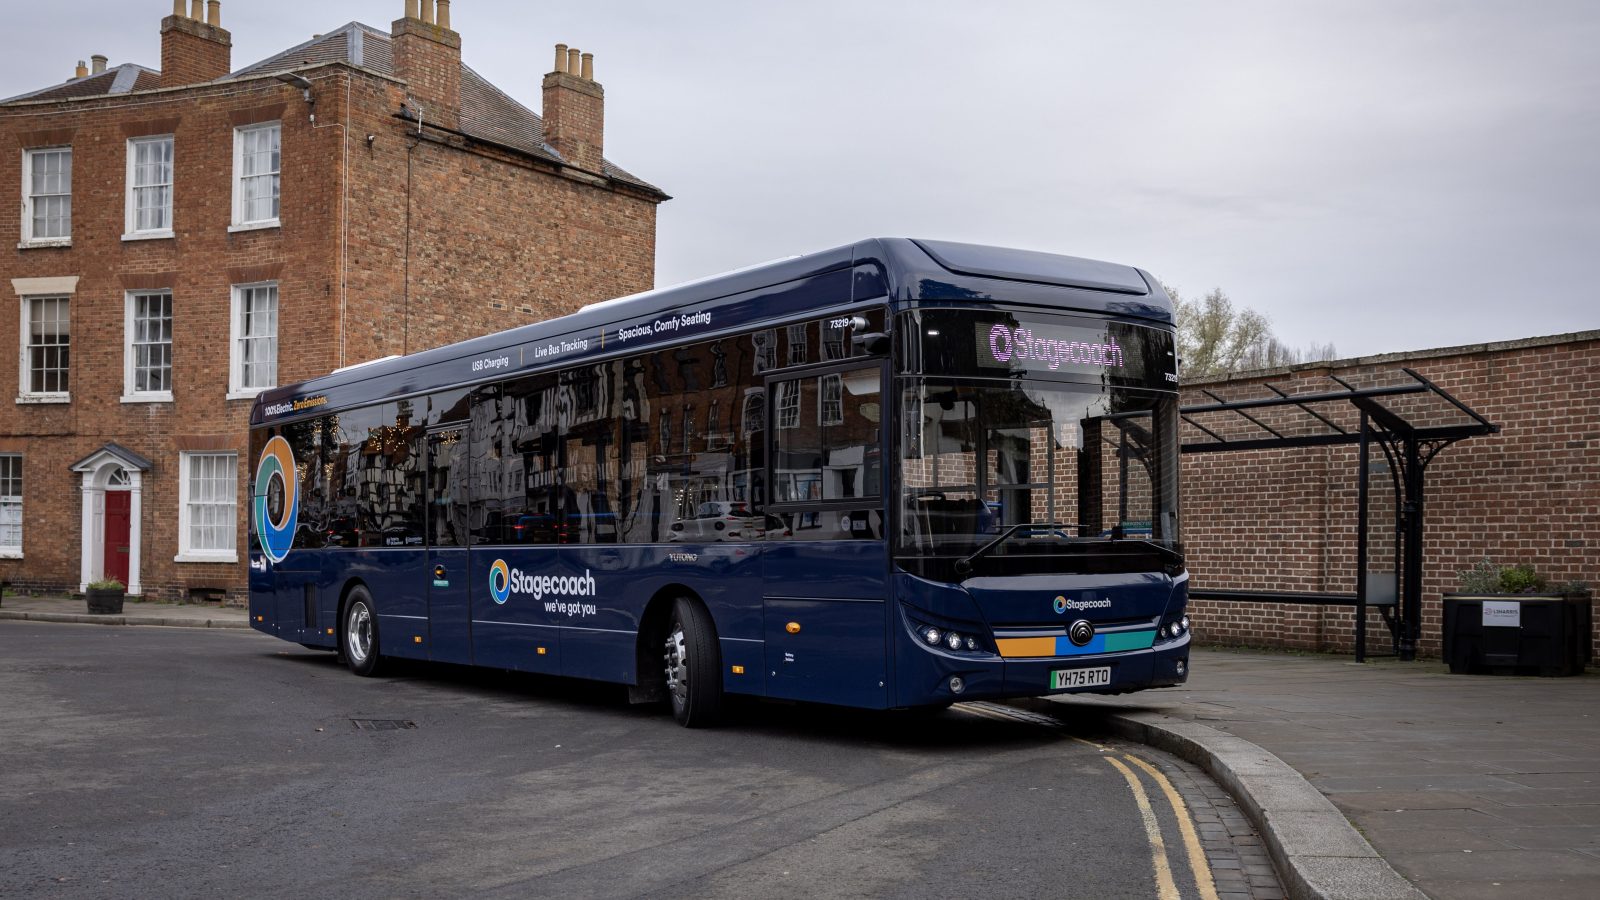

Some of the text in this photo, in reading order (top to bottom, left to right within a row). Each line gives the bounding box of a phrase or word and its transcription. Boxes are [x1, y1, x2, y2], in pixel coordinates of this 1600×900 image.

[618, 311, 711, 342] Spacious, Comfy Seating
[830, 318, 849, 329] 73219
[534, 338, 588, 358] Live Bus Tracking
[1013, 327, 1123, 370] Stagecoach
[472, 355, 509, 371] USB Charging
[510, 567, 596, 601] Stagecoach
[544, 599, 596, 618] we've got you
[1066, 597, 1111, 611] Stagecoach
[1058, 669, 1108, 686] YH75 RTO
